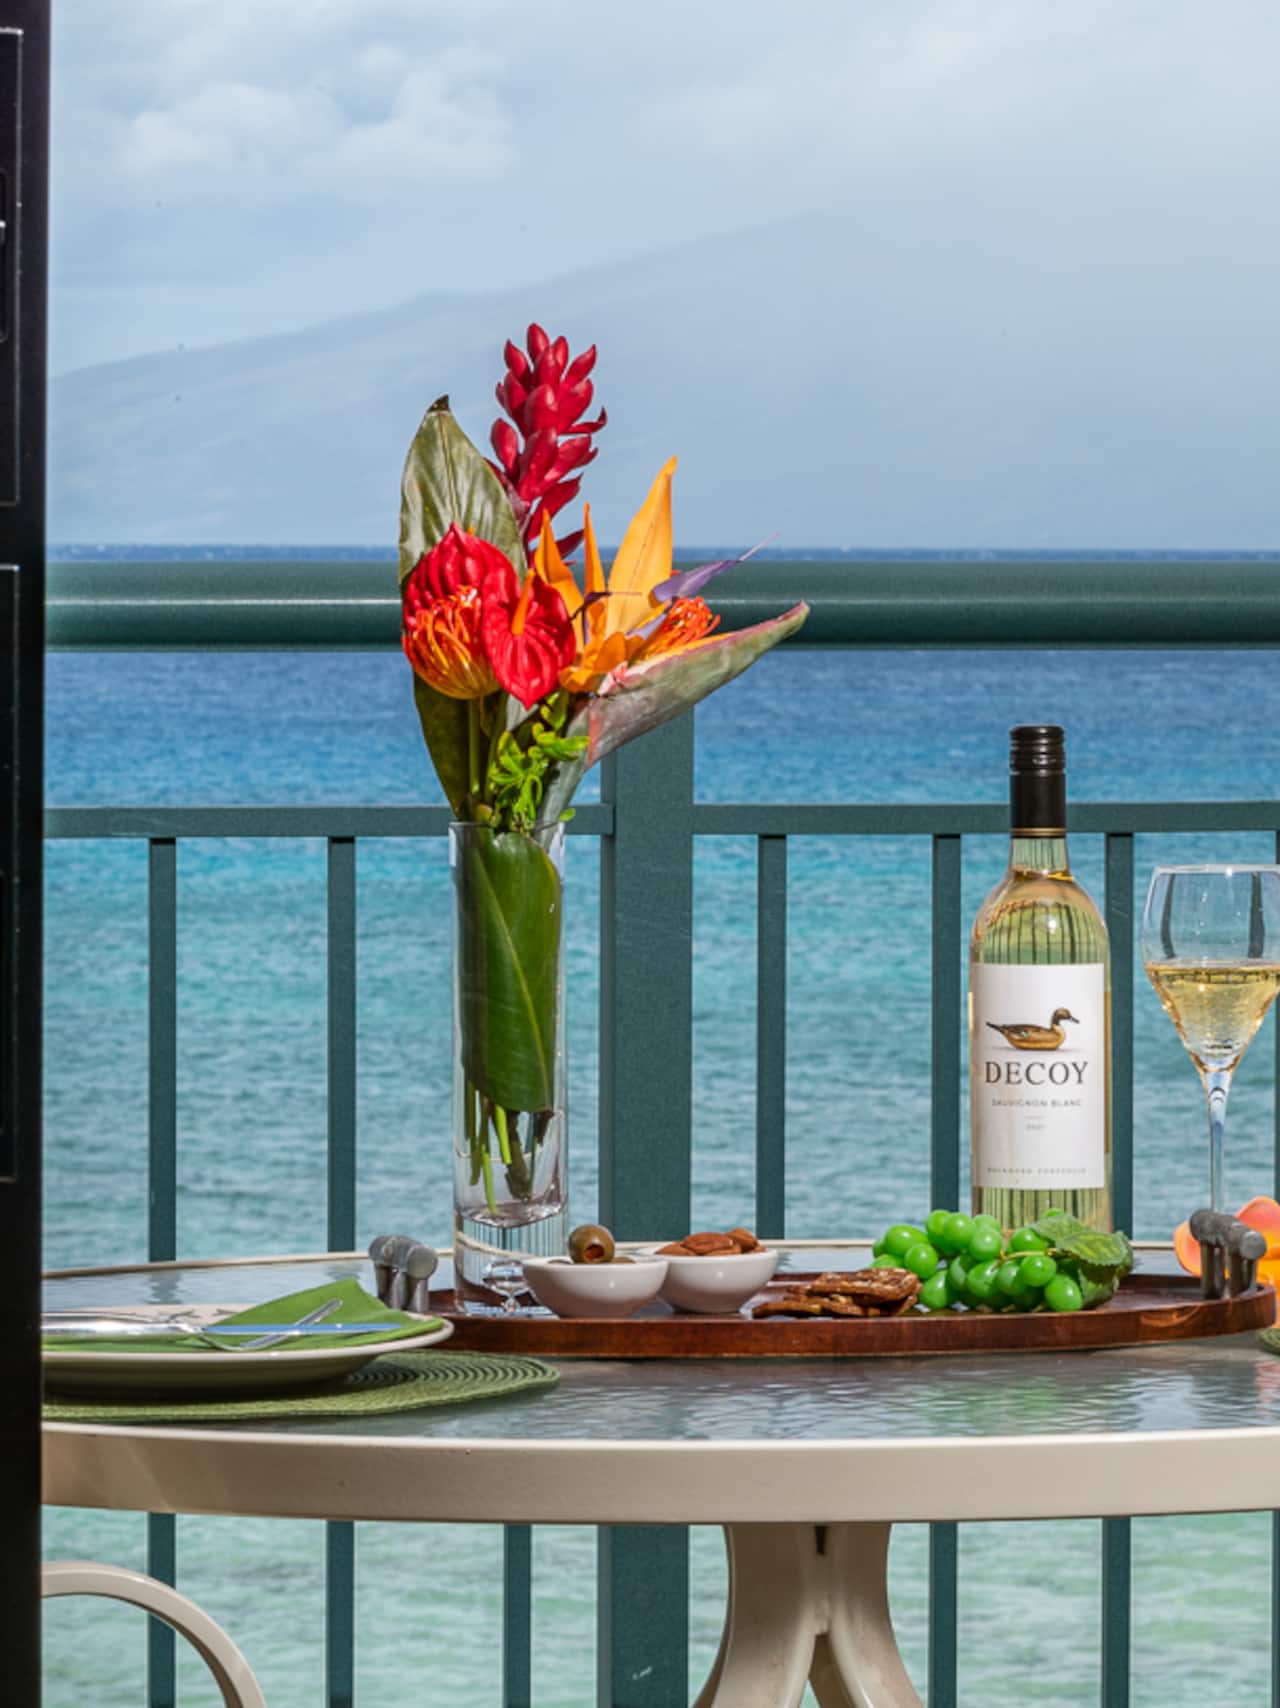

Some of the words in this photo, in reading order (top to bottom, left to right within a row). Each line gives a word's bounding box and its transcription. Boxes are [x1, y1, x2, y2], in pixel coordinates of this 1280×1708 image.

[984, 1061, 1088, 1085] DECOY
[991, 1098, 1048, 1107] SAUVIGNON
[1051, 1098, 1082, 1107] BLANC
